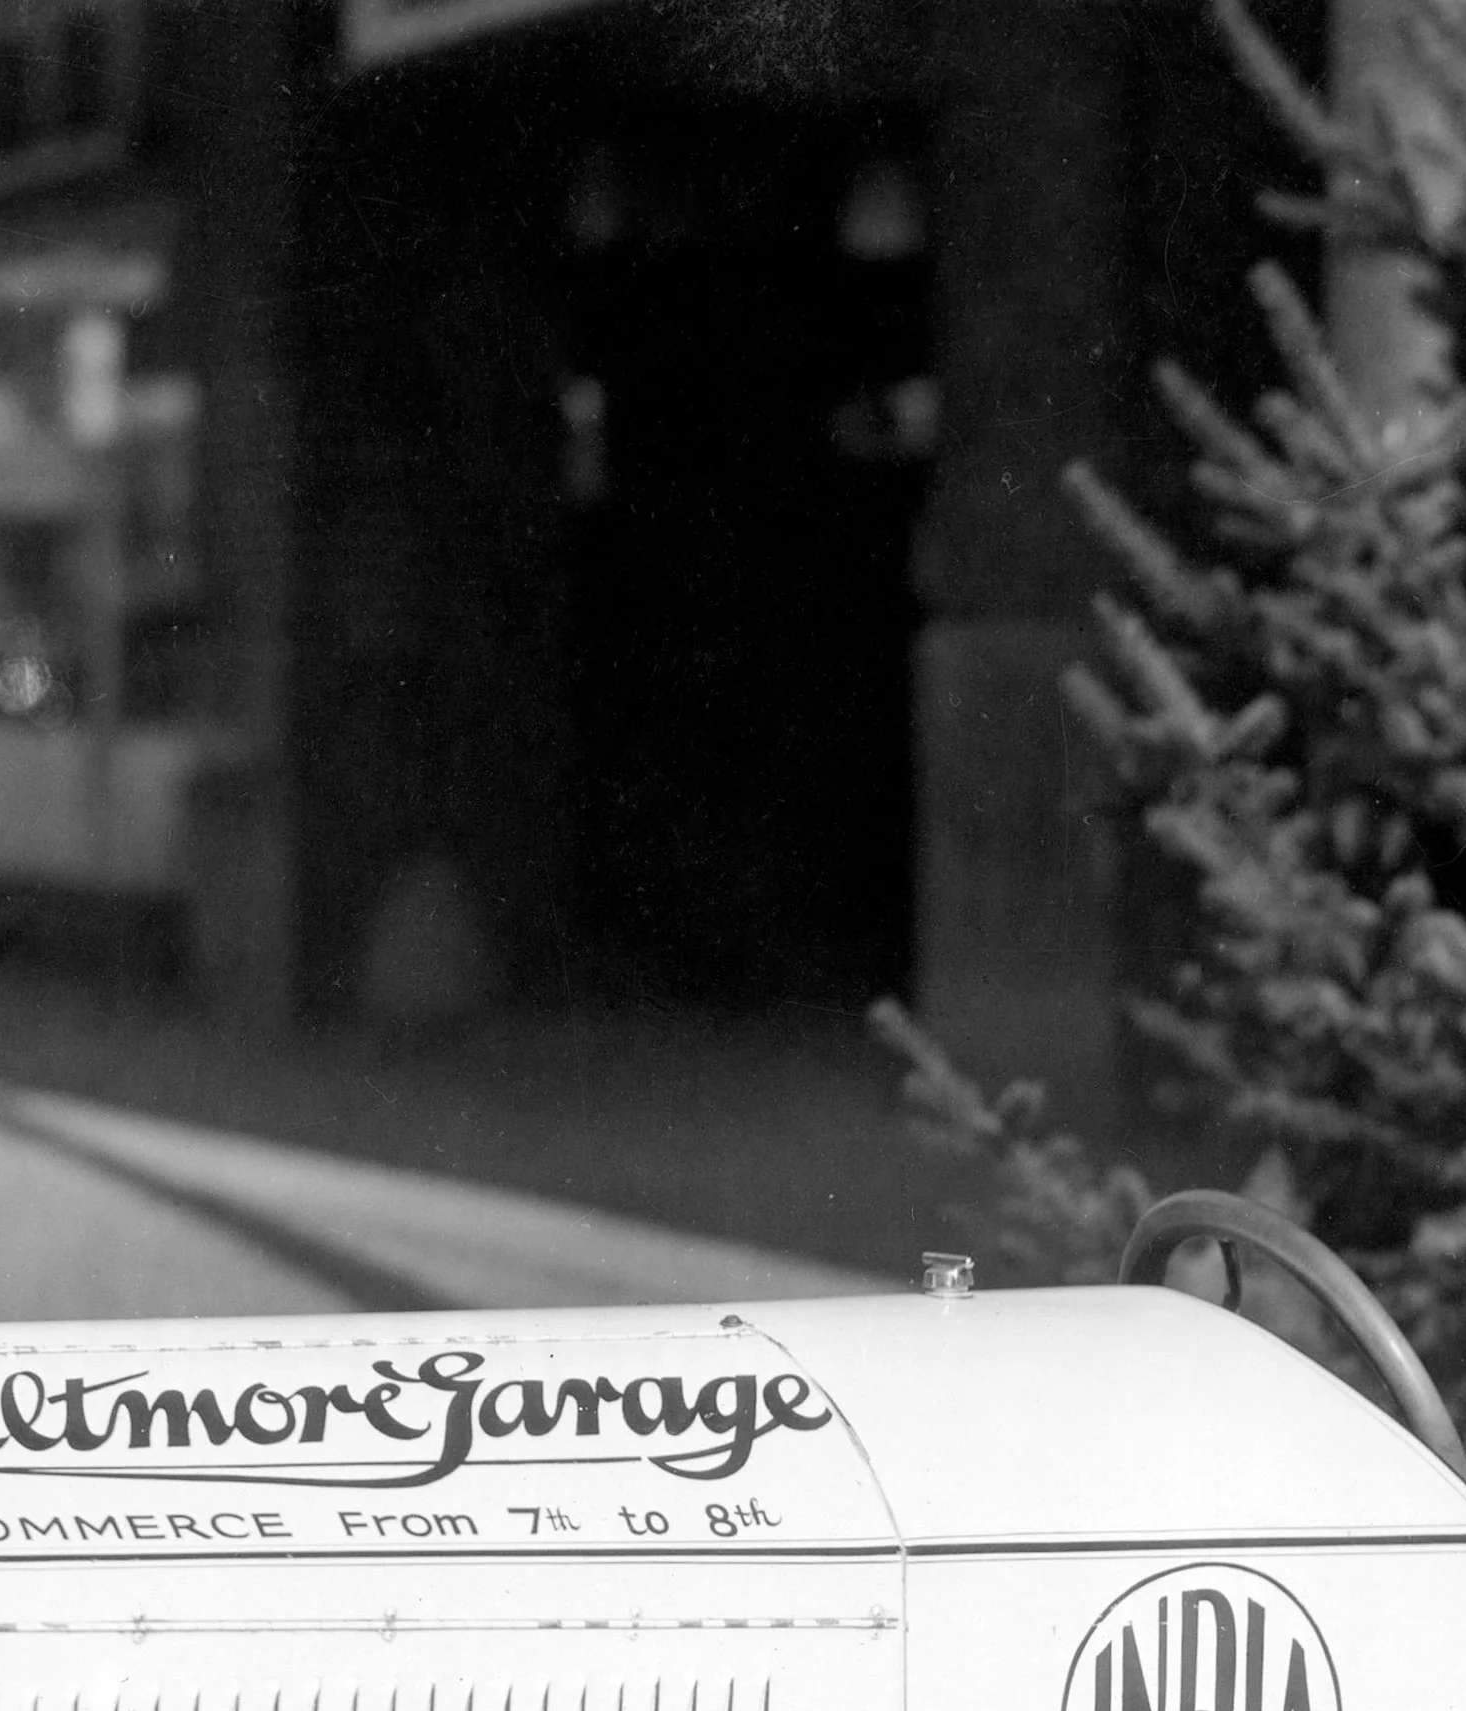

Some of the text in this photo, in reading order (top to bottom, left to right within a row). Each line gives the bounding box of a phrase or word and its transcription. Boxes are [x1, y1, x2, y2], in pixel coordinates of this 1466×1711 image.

[371, 1351, 832, 1489] Garage
[337, 1510, 479, 1537] From
[506, 1506, 582, 1535] 7th
[618, 1504, 670, 1535] to
[705, 1496, 783, 1538] 8th
